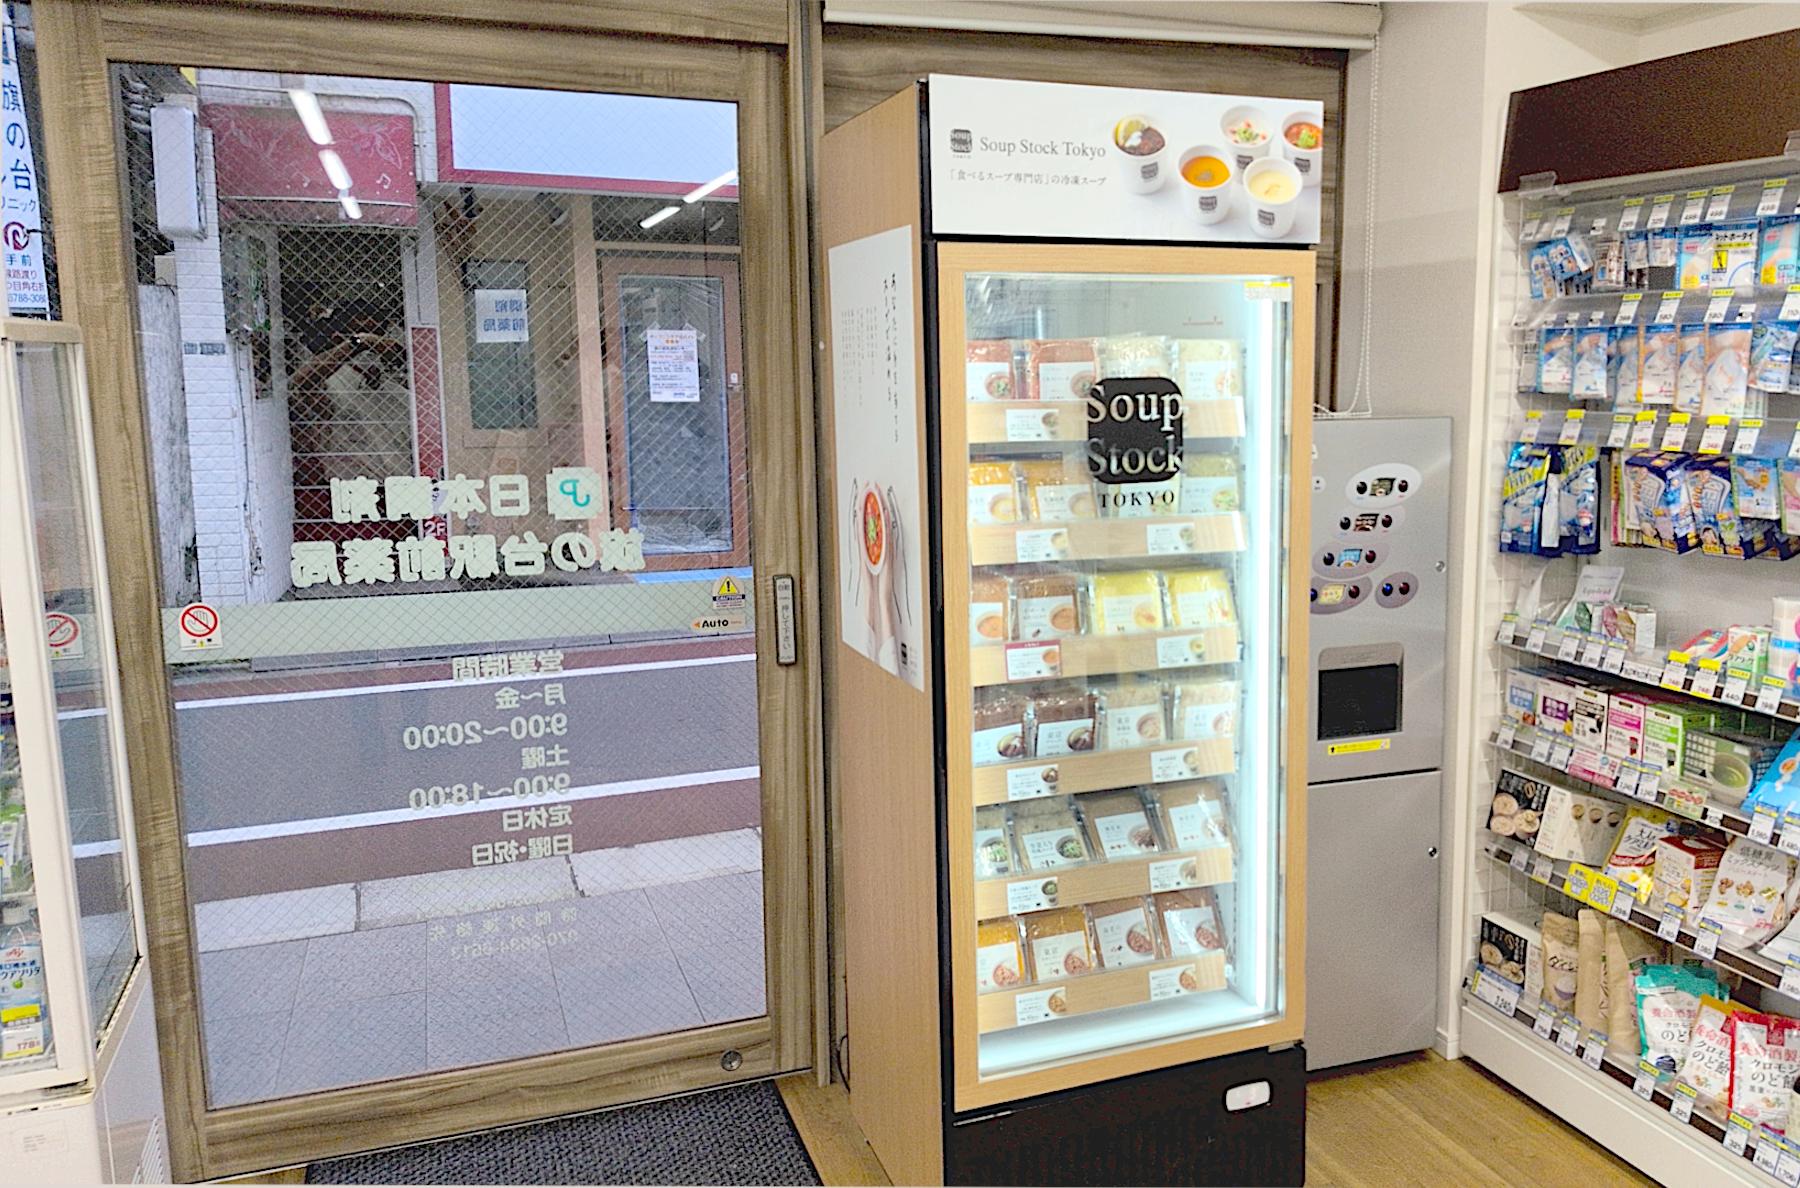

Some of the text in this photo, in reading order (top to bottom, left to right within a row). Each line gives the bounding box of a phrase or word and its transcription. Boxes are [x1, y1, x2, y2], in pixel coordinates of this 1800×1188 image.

[980, 137, 1107, 161] Soup Stock Tokyo
[950, 168, 1107, 186] 「食べるスープ専門店」の冷凍スープ
[6, 254, 32, 267] 手前
[1088, 385, 1183, 432] Soup
[1088, 435, 1183, 476] Stock
[1099, 490, 1175, 508] TOKYO
[702, 619, 729, 628] Auto
